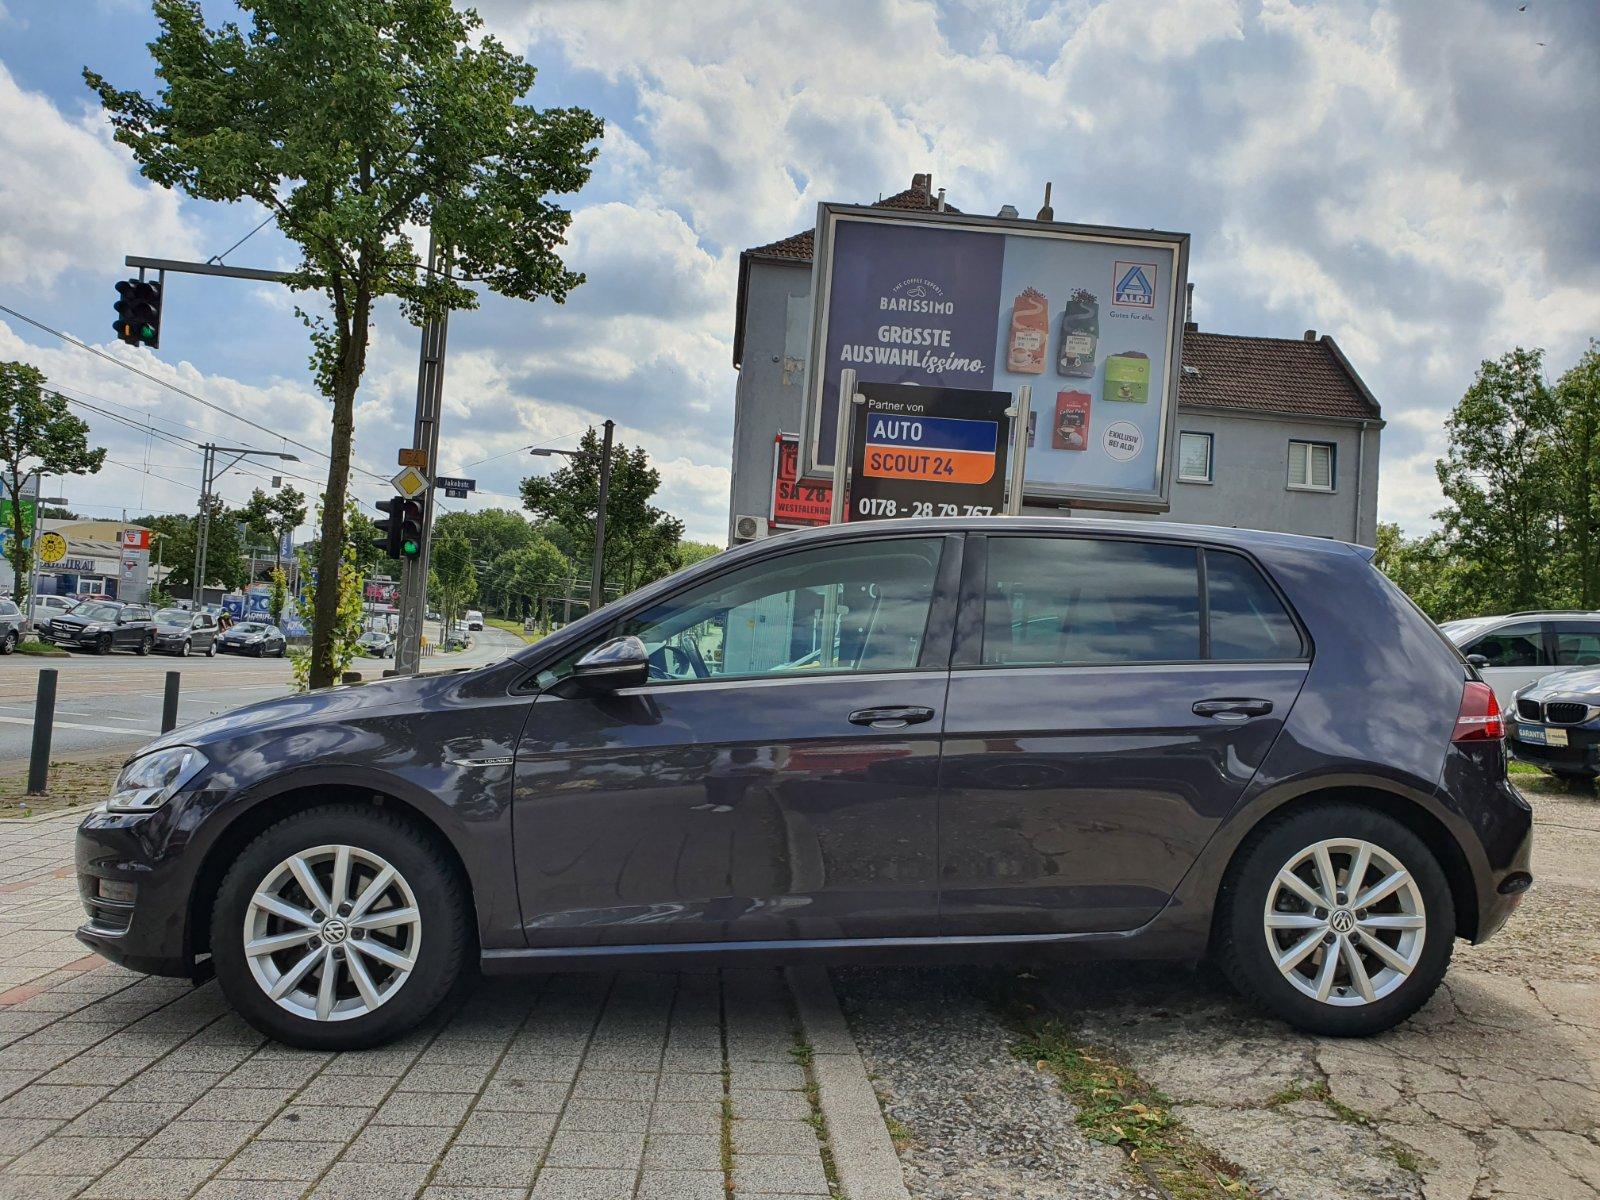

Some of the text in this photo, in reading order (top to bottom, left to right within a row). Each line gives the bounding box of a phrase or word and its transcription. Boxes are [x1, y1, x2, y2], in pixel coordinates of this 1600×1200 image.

[879, 296, 955, 315] BARISSIMO
[1118, 294, 1150, 304] ALDI
[1109, 310, 1129, 319] Gutes
[878, 325, 952, 347] GRÖSSTE
[840, 344, 986, 374] AUSWAHLissimo.
[868, 399, 925, 413] Partner von
[873, 419, 923, 442] AUTO
[1108, 429, 1139, 444] EXKLUSIV
[1108, 439, 1135, 452] BEI ALDI
[779, 482, 799, 500] SA
[805, 487, 830, 503] 28.
[859, 498, 897, 517] 0178
[912, 502, 933, 518] 28
[937, 503, 959, 518] 79
[963, 505, 994, 518] 767
[1518, 729, 1546, 740] GARANTIE
